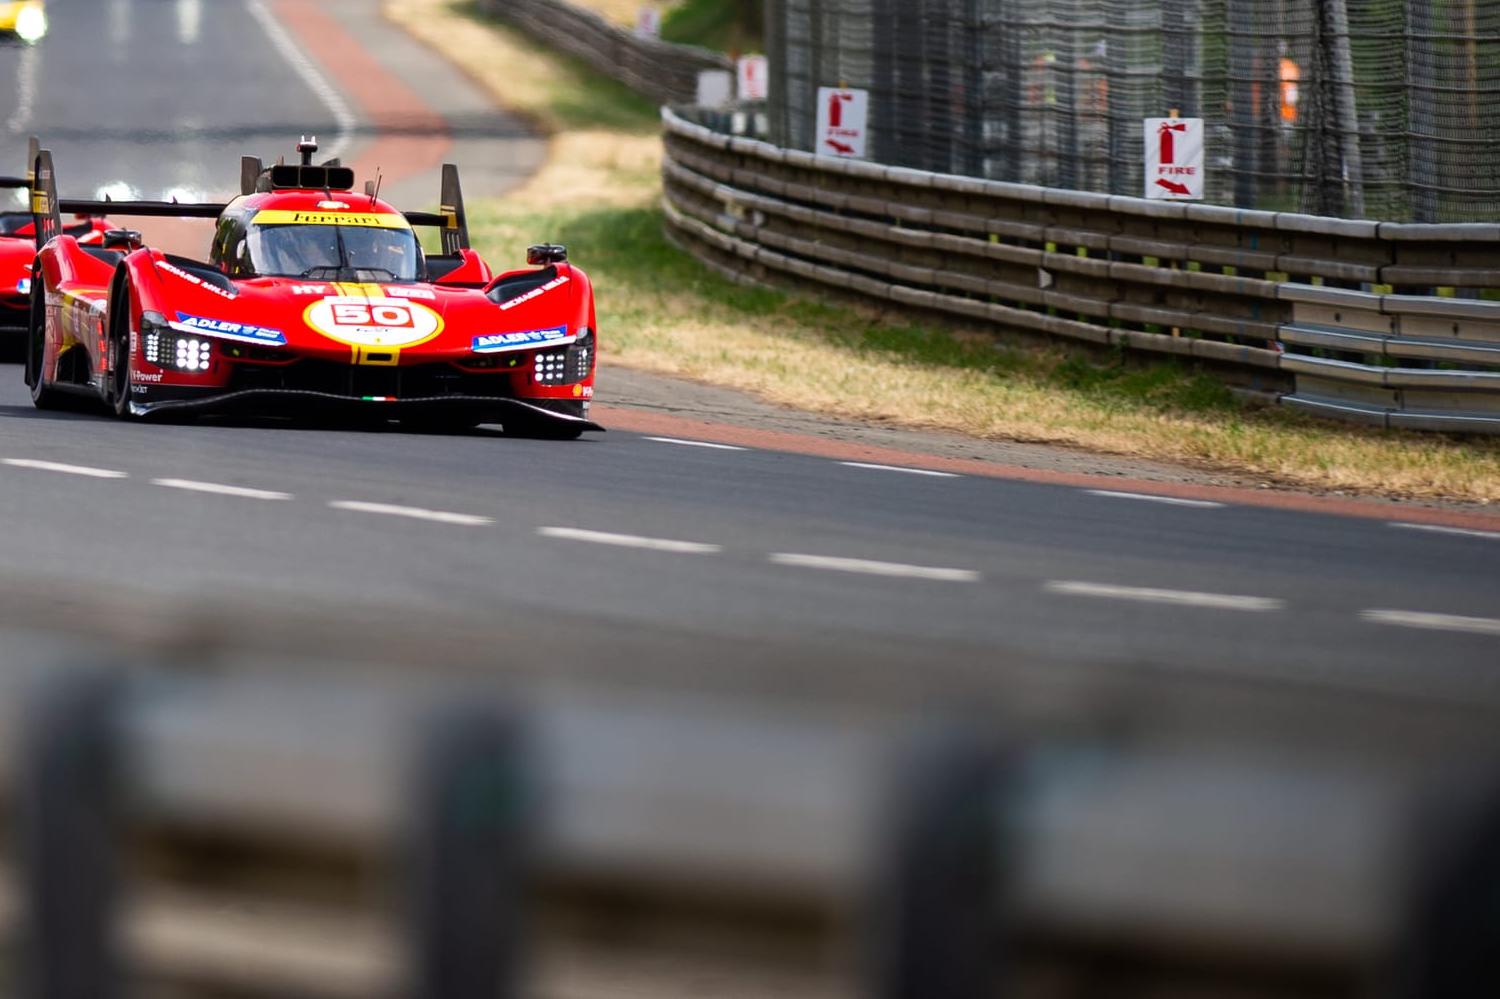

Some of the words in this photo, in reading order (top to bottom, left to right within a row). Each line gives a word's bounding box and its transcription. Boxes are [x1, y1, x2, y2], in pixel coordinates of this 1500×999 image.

[1157, 166, 1197, 176] FIRE
[293, 212, 381, 225] Ferrari
[200, 281, 237, 301] MILLE
[291, 285, 326, 295] HY
[334, 305, 411, 326] 50
[181, 316, 242, 333] ADLER
[478, 331, 530, 346] ADLER
